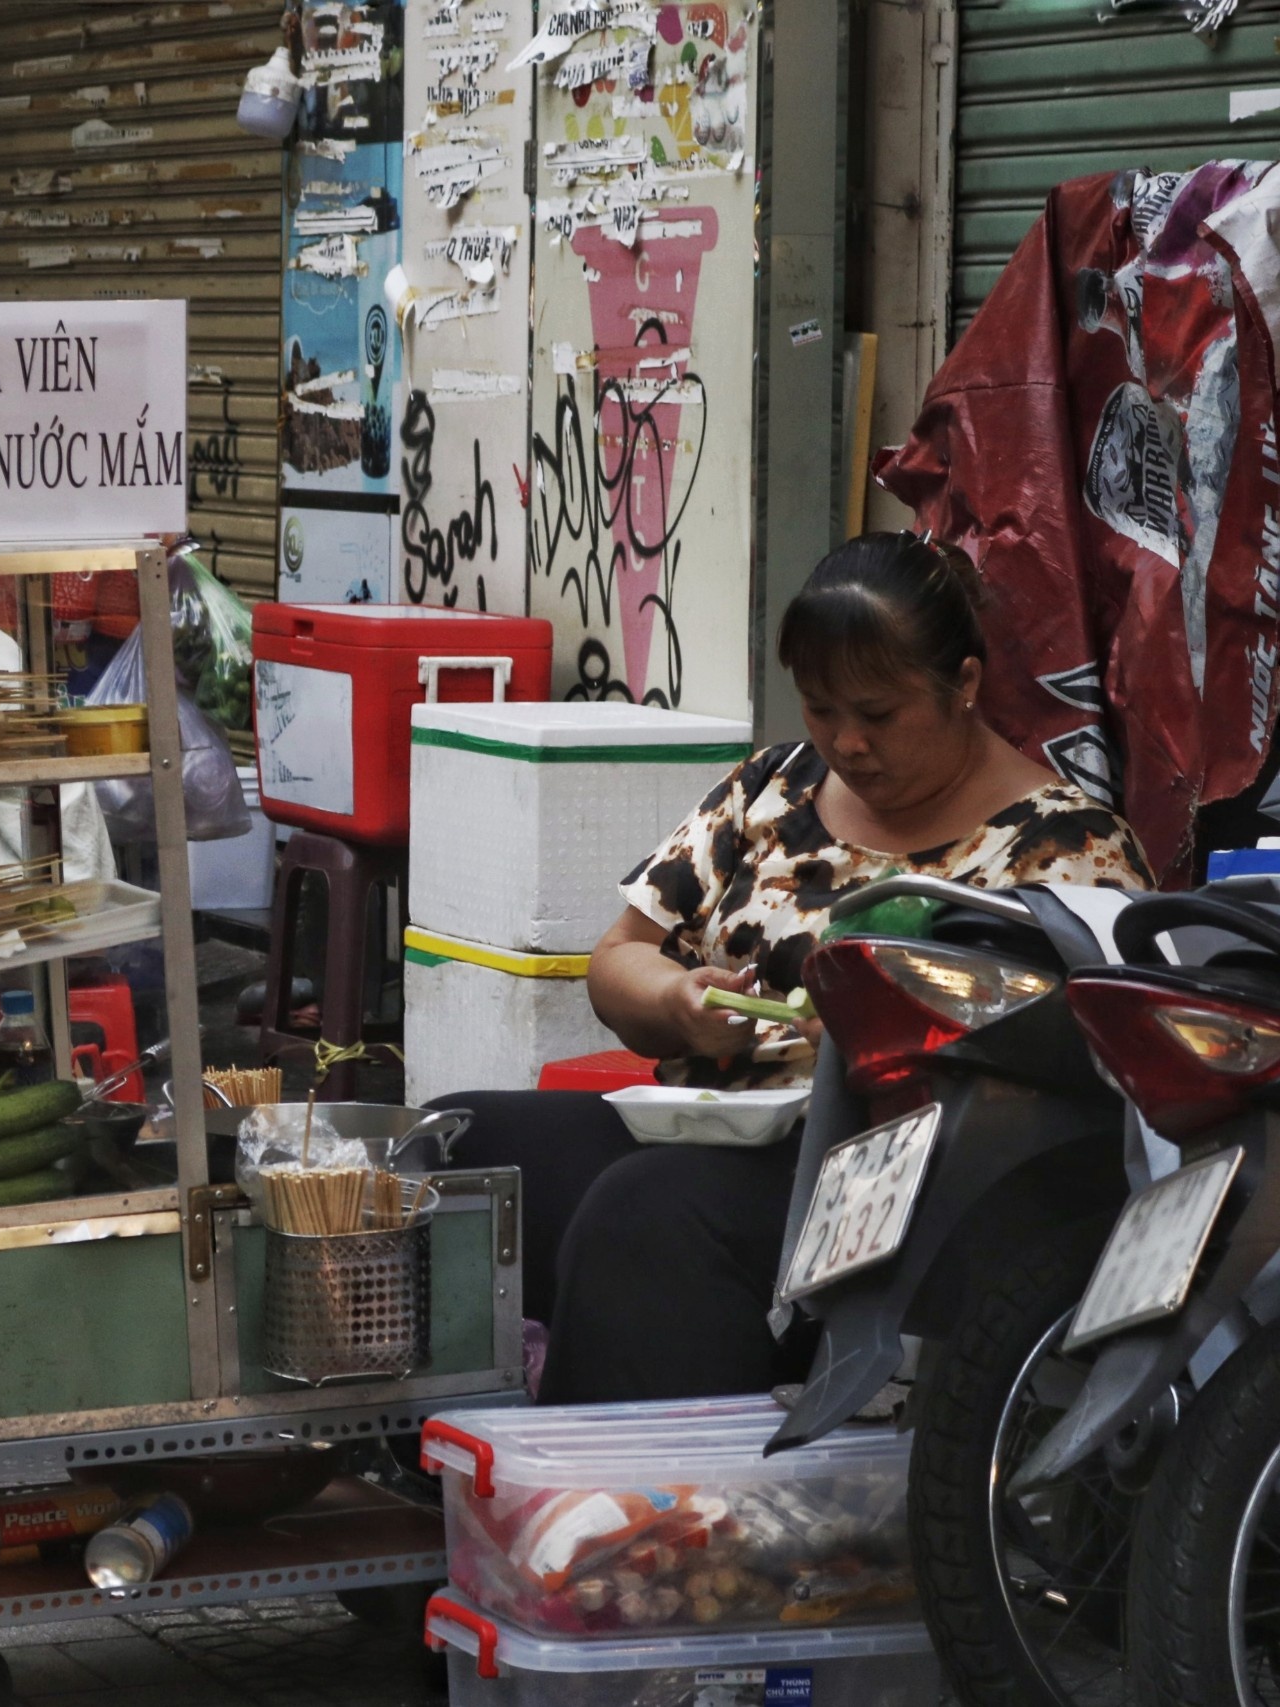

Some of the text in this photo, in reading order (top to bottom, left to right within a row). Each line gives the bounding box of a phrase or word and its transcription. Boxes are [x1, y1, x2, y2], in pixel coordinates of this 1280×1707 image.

[15, 319, 99, 393] VIÊN
[98, 403, 183, 488] MẮM
[1244, 632, 1277, 755] NƯỚC
[5, 1509, 68, 1528] Peace
